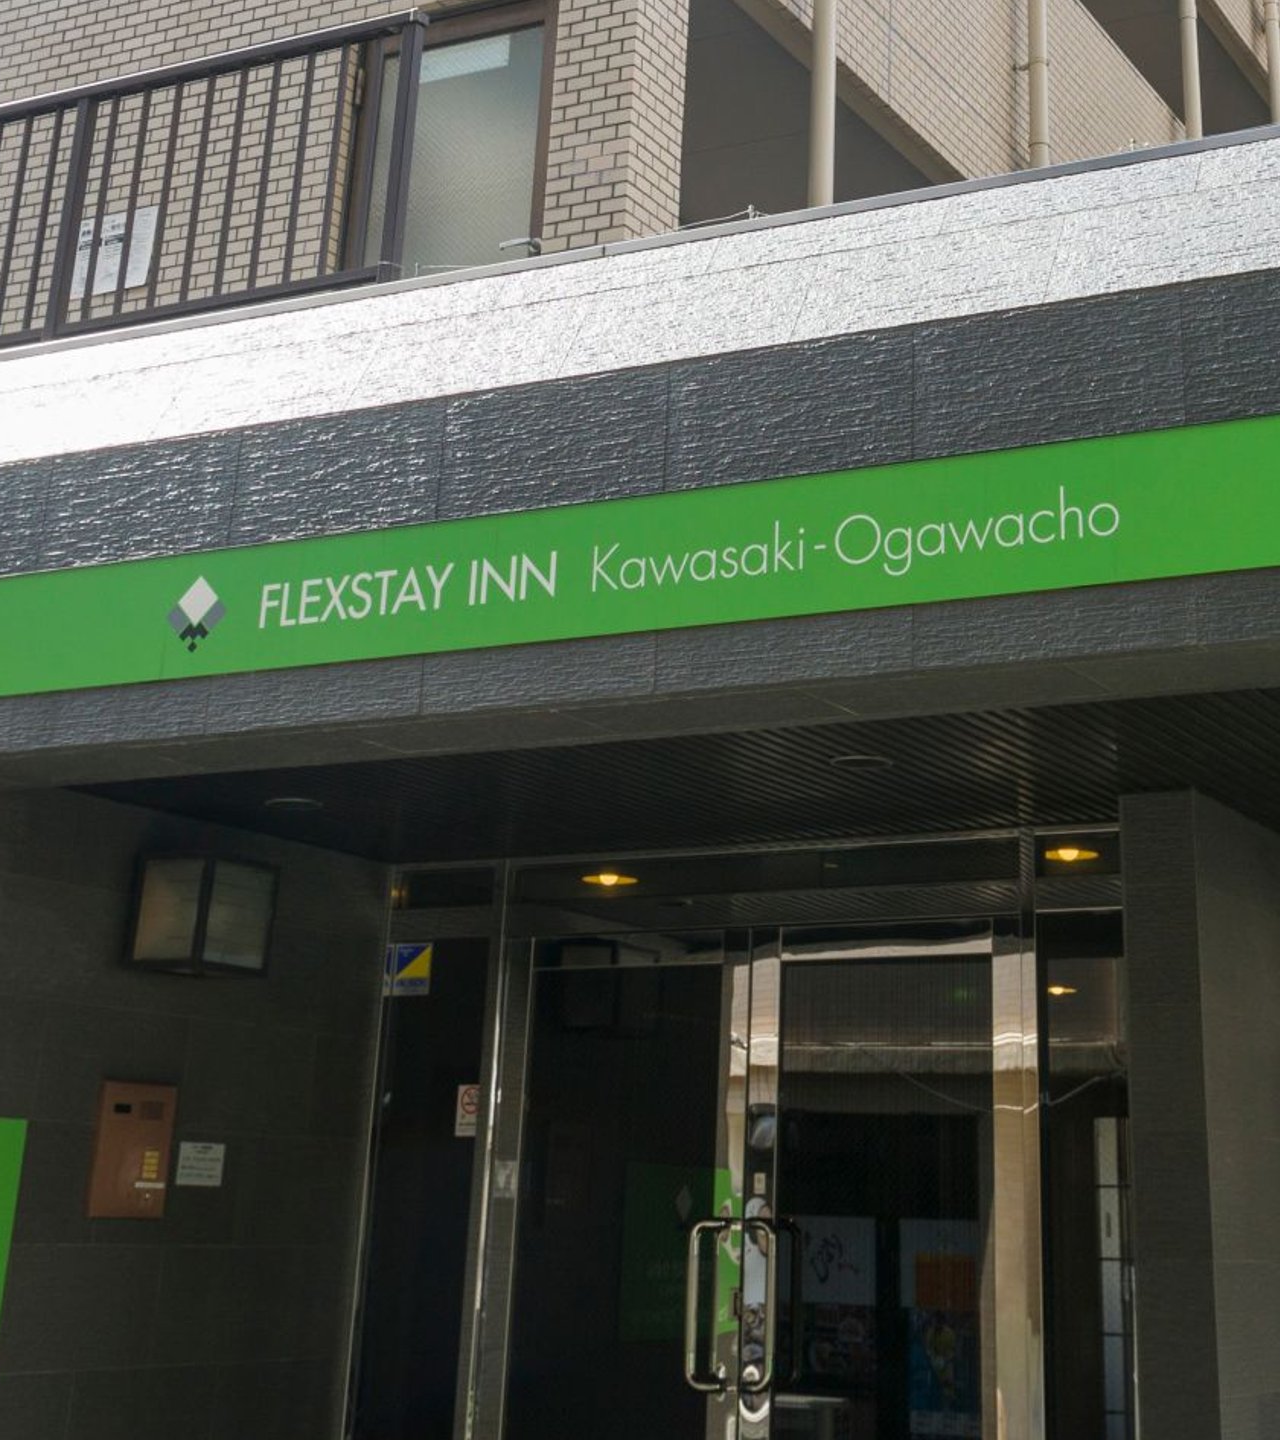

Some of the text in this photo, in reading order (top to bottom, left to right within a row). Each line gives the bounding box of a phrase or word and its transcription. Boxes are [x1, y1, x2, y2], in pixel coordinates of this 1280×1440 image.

[258, 485, 1121, 629] FLEXSTAY INN Kawasaki-Ogawacho
